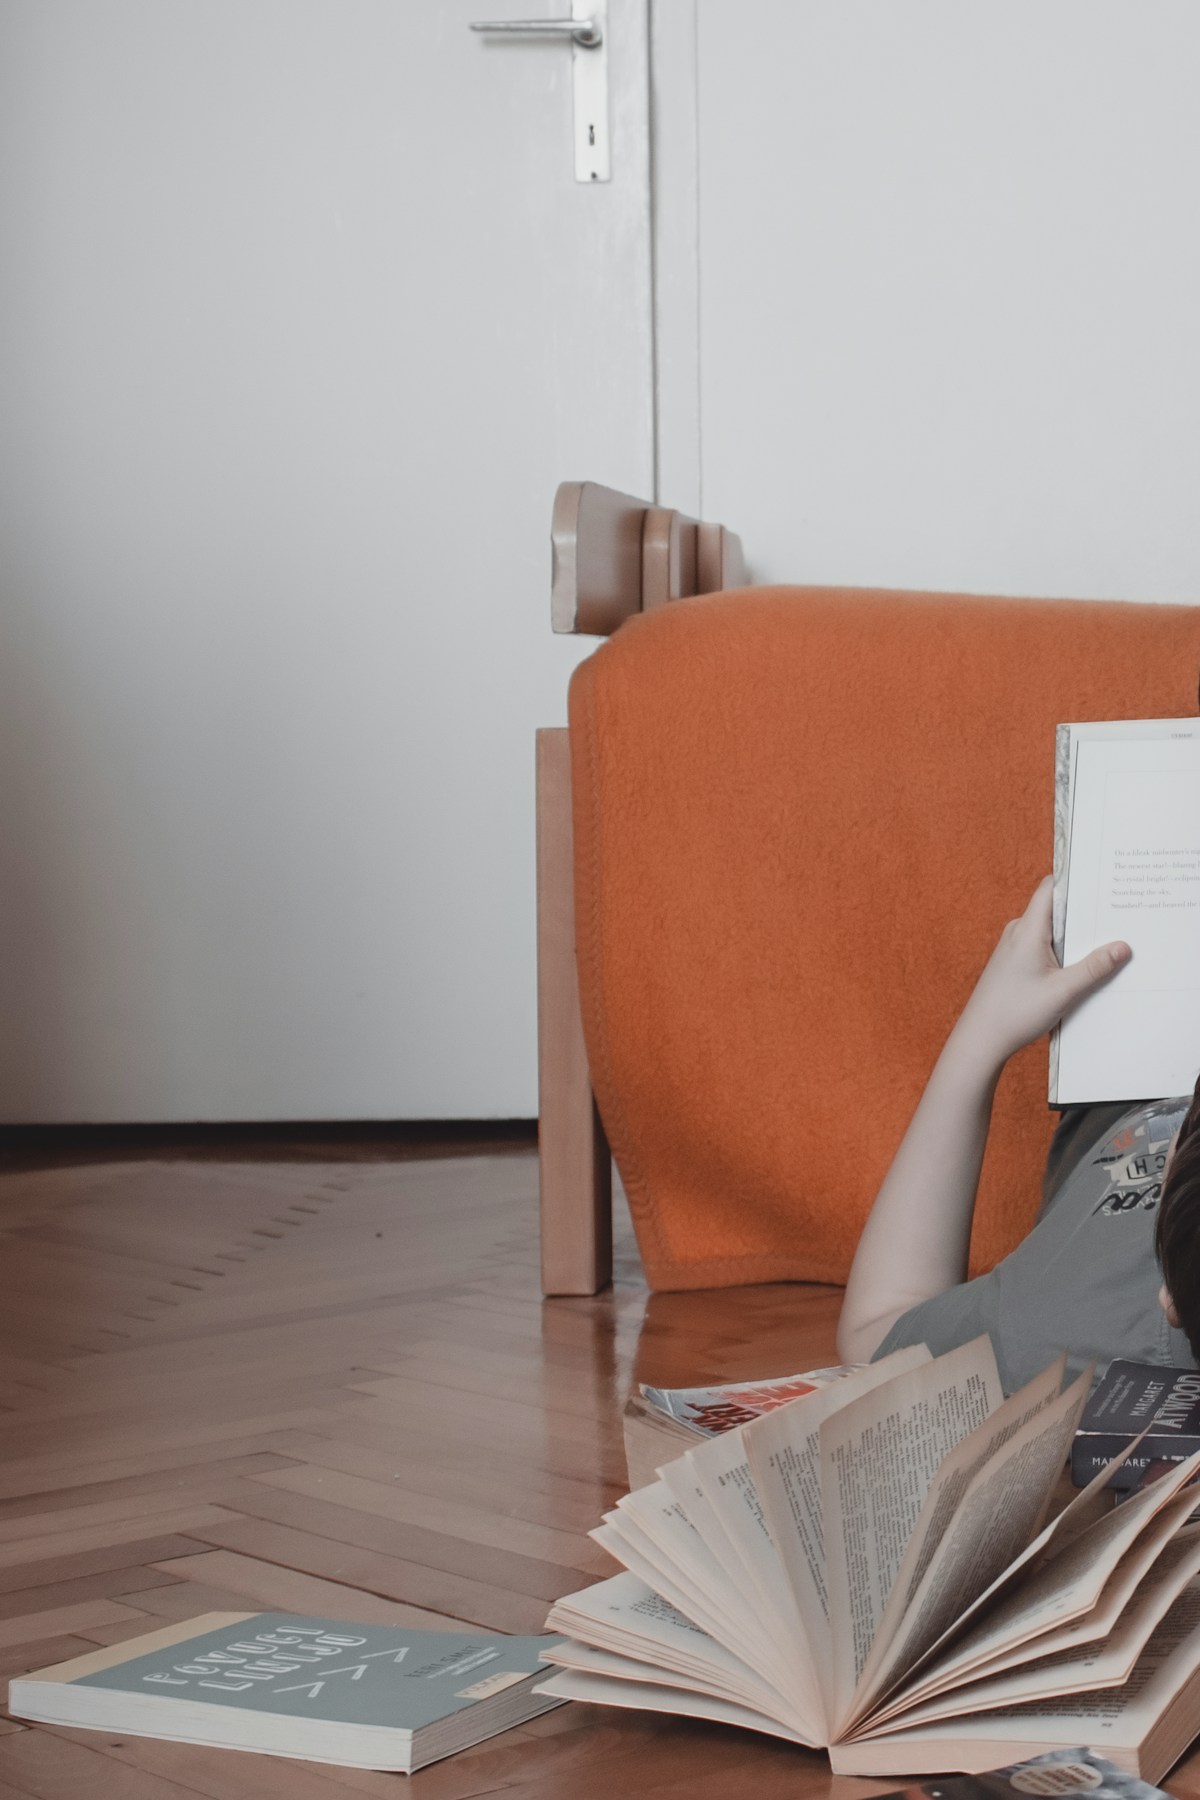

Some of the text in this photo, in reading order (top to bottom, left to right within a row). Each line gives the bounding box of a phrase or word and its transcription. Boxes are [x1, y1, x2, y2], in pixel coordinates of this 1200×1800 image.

[1111, 888, 1144, 897] Scorching
[1130, 1380, 1165, 1416] MARGARET
[198, 1633, 368, 1692] LINIJU
